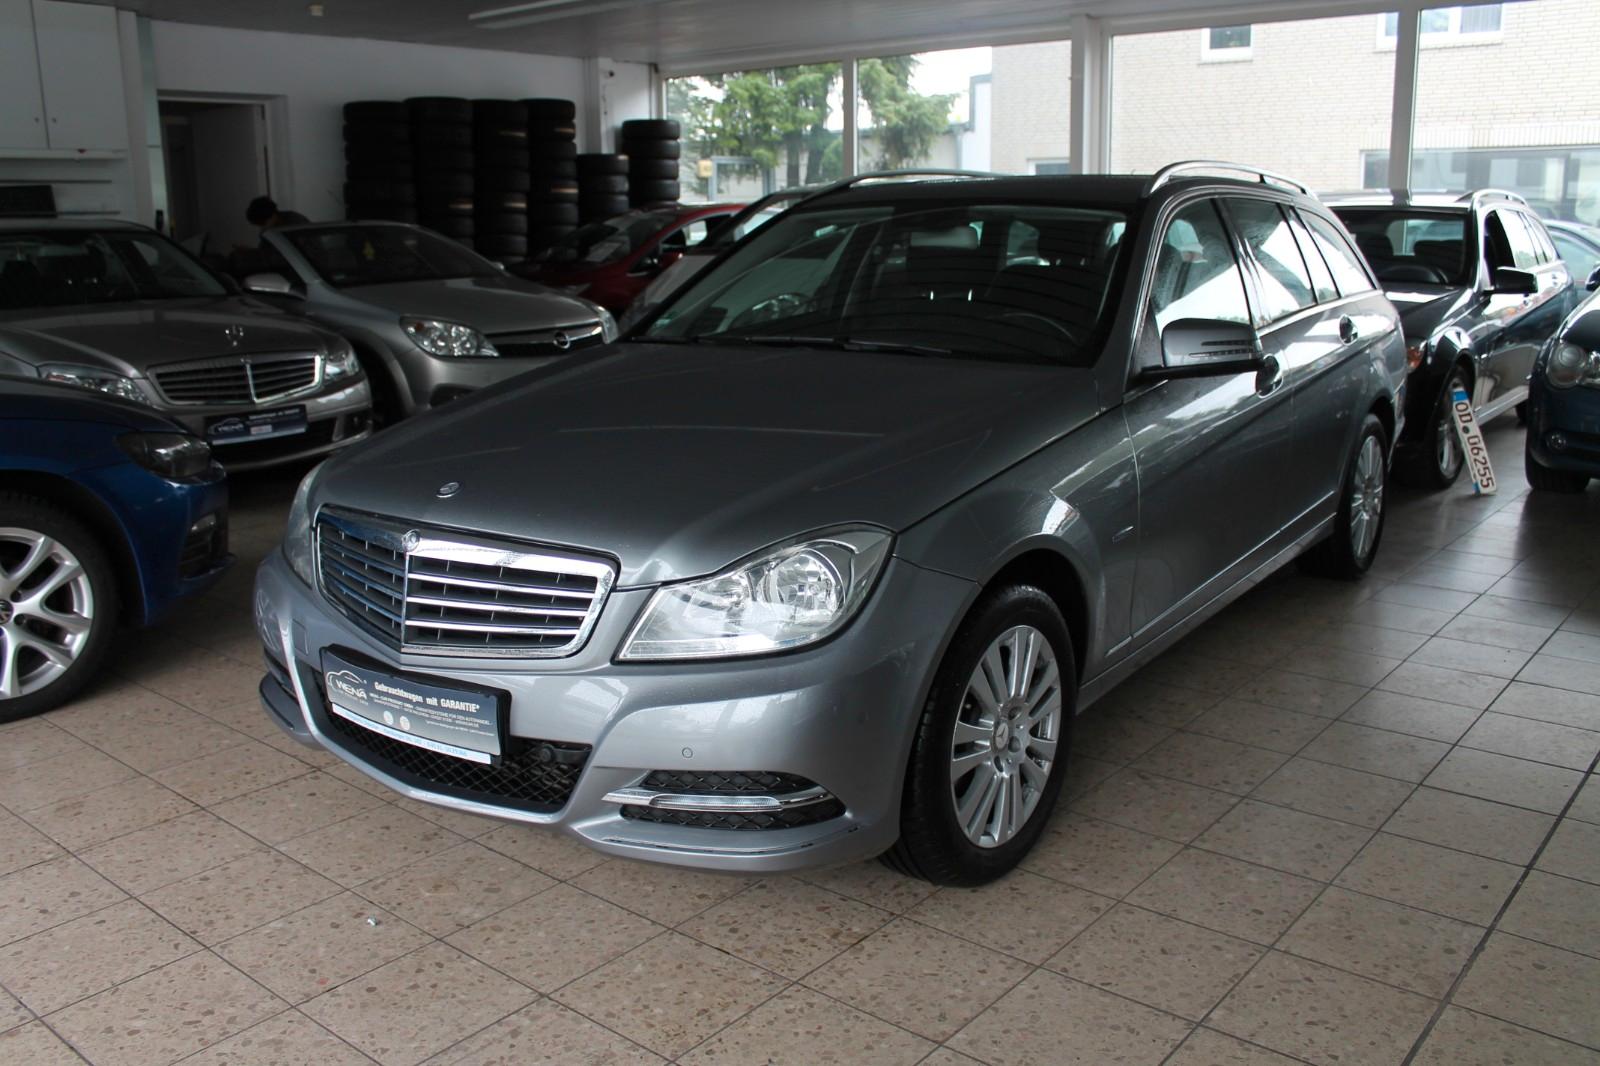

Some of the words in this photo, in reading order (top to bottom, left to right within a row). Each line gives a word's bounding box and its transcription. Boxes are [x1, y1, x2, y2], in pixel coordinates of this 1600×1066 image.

[1455, 402, 1473, 424] OD
[1467, 435, 1495, 489] 06255
[374, 681, 424, 703] Gebrauchtwagen
[426, 697, 439, 706] mit
